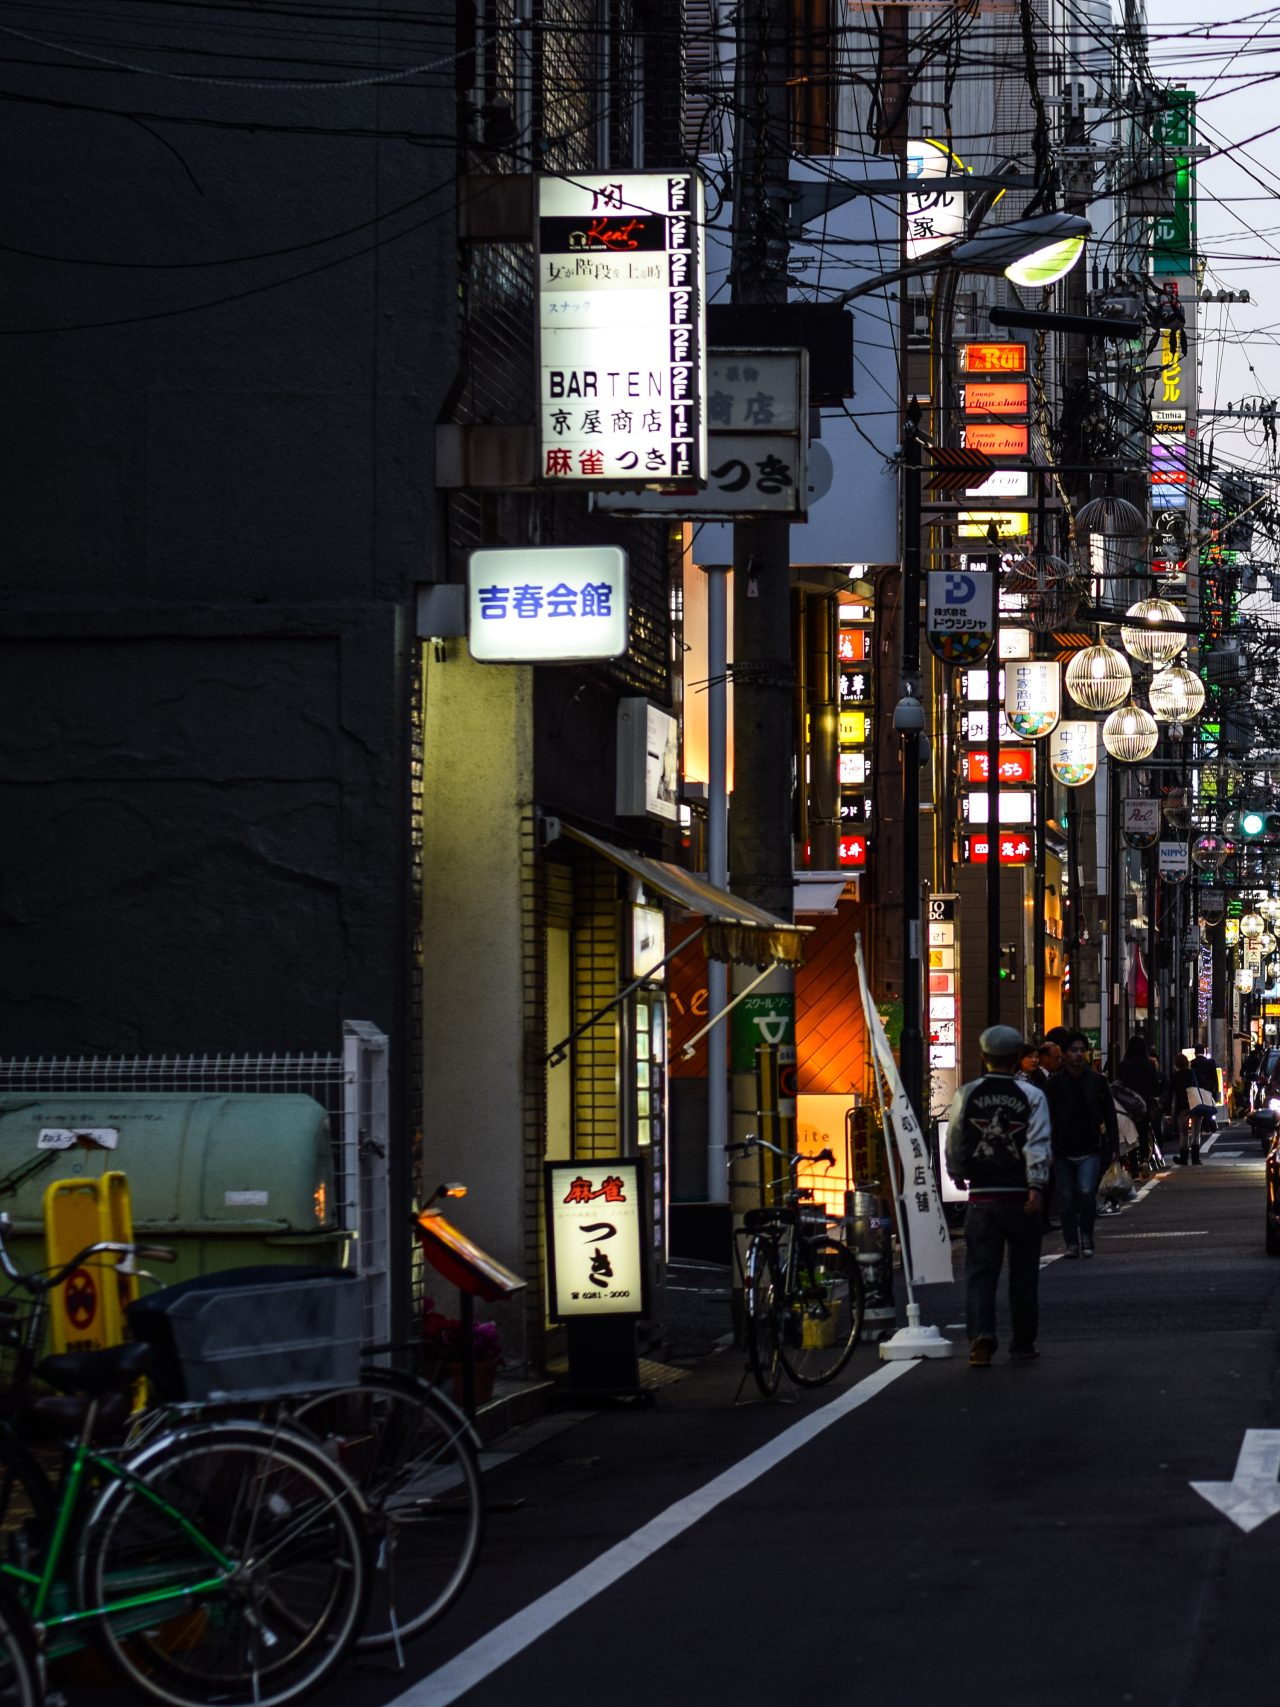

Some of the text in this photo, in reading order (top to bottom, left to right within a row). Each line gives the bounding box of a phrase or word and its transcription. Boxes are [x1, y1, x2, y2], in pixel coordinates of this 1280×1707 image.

[913, 217, 934, 237] 家
[549, 370, 663, 398] BAR TEN
[549, 407, 662, 436] 京屋商店
[545, 447, 667, 476] 麻雀 つき
[710, 454, 793, 494] つき
[478, 584, 614, 620] 吉春会館
[934, 608, 968, 617] 株式会社
[1160, 849, 1187, 857] NIPPO
[973, 1094, 1026, 1113] VANSON
[563, 1175, 627, 1204] 麻雀
[579, 1222, 617, 1289] つき
